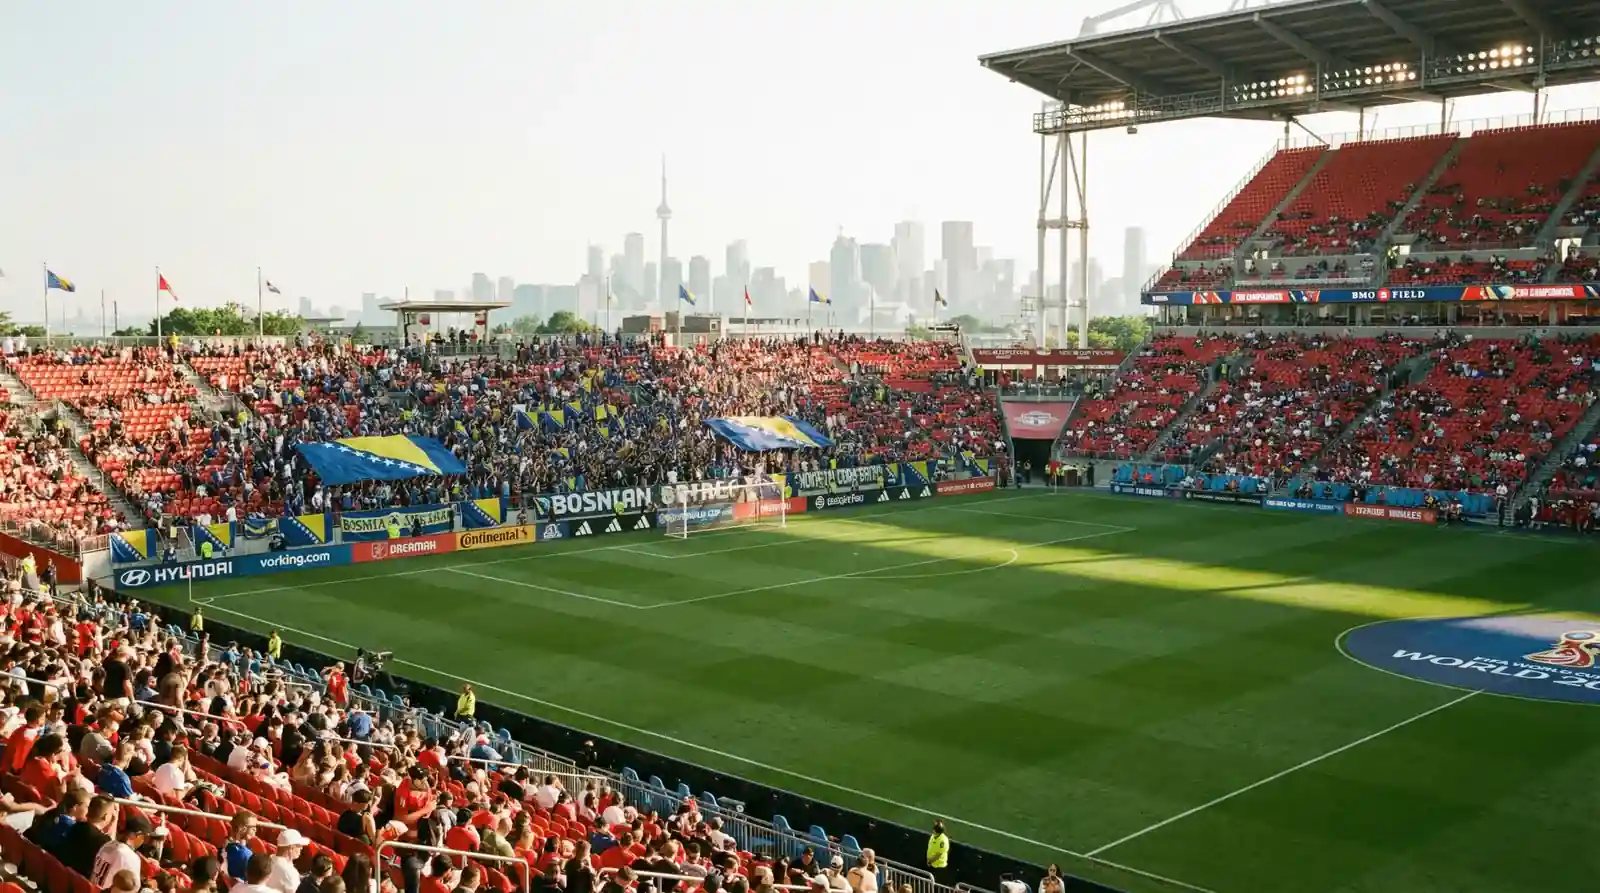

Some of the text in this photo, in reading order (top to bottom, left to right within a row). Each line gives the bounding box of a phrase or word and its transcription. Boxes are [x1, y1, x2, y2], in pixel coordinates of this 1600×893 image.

[1351, 290, 1425, 299] BMO FIELD
[550, 487, 652, 515] BOSNIAN
[459, 528, 519, 548] Continental
[260, 550, 330, 569] vorking.com
[154, 561, 233, 582] HYUNDAI
[1392, 649, 1550, 680] WORLD
[1473, 656, 1508, 665] FIFA
[1512, 661, 1573, 674] WORLD
